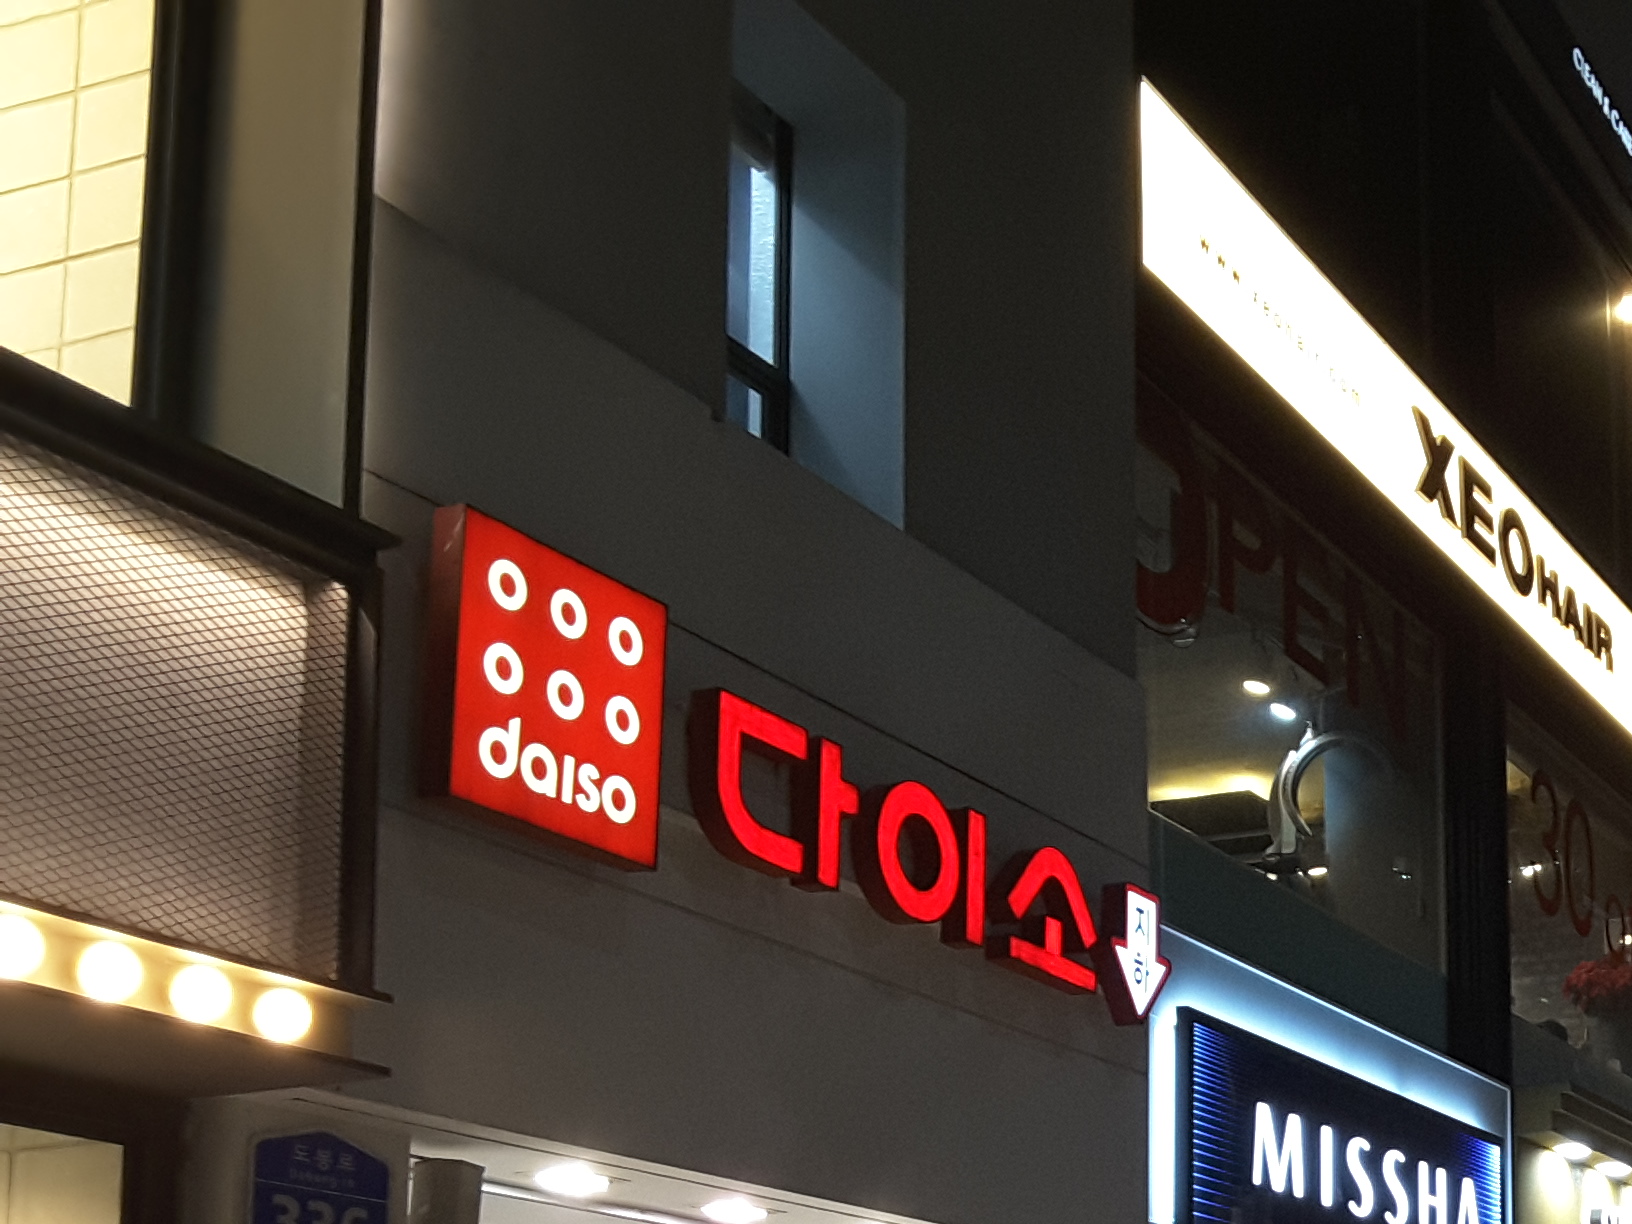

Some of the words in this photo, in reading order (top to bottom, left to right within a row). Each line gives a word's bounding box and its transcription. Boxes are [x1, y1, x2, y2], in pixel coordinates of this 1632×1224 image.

[1412, 404, 1536, 599] XEO
[1536, 554, 1614, 673] HAIR
[478, 717, 637, 825] daiso
[717, 689, 1097, 995] 다이소
